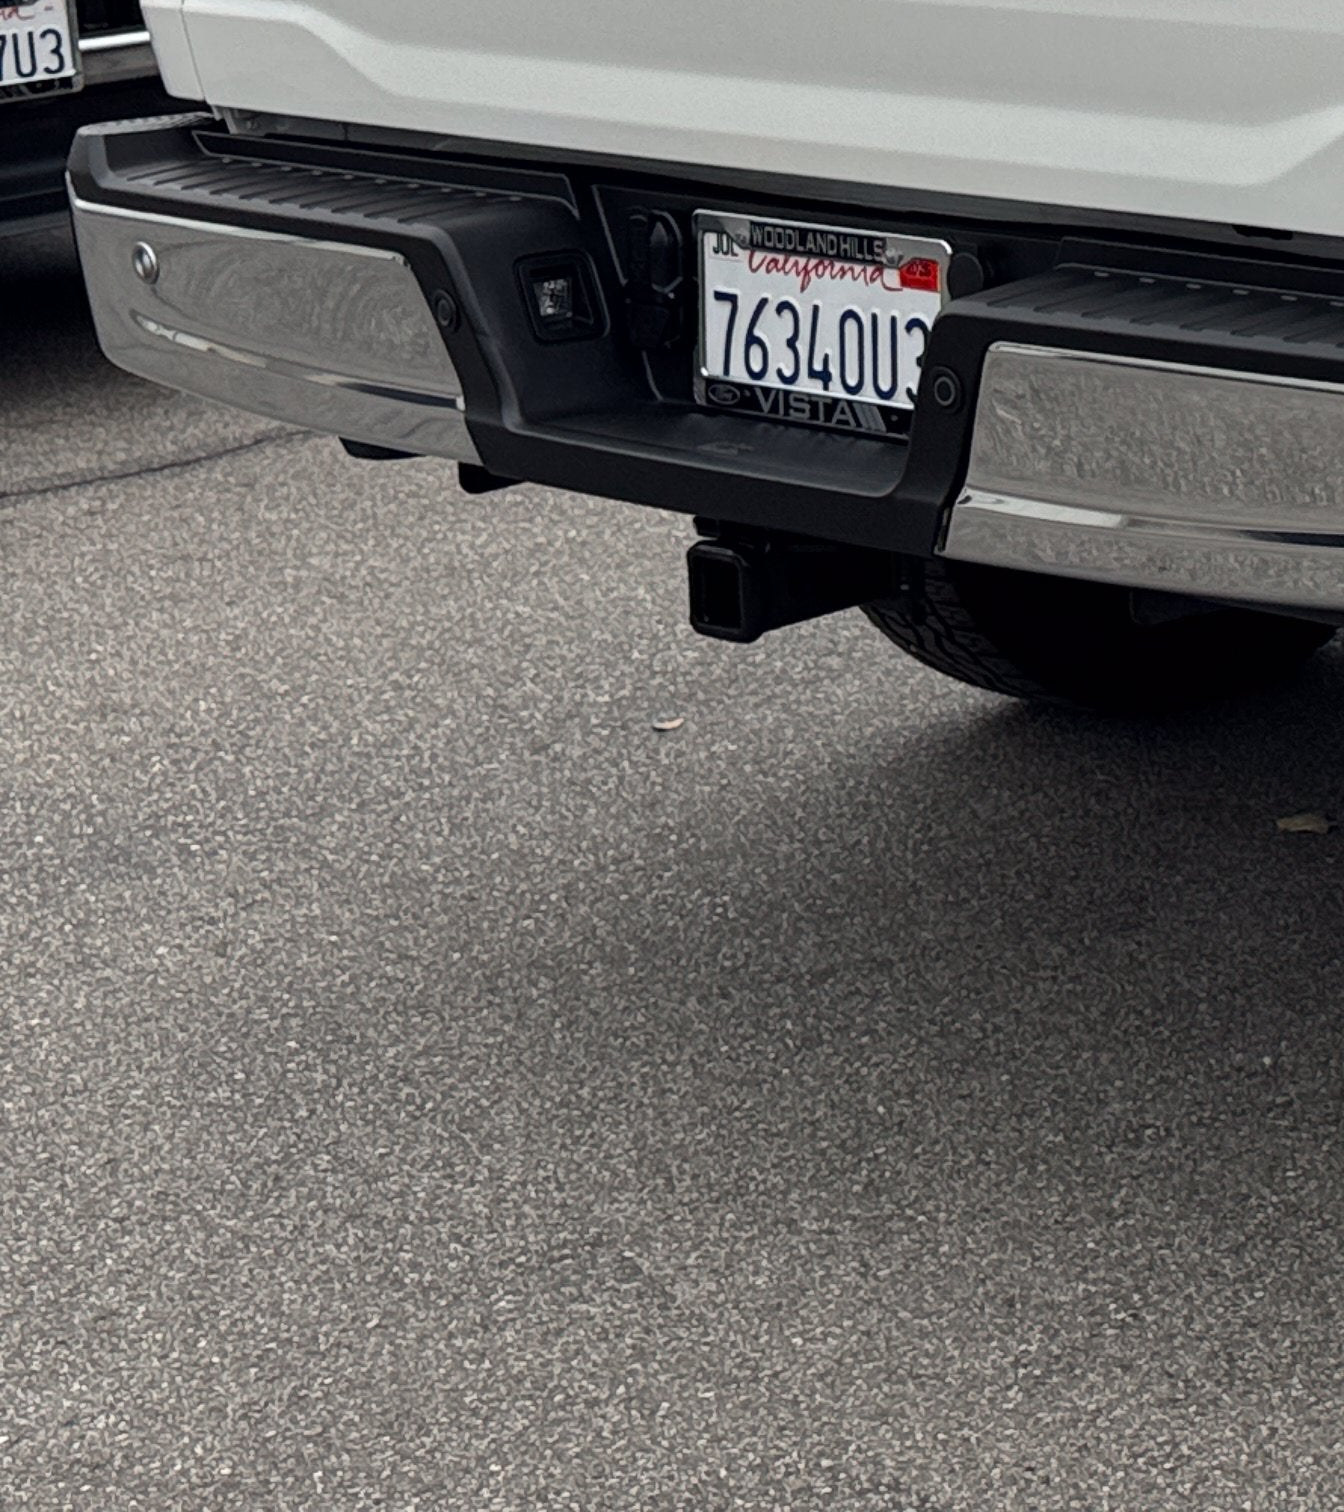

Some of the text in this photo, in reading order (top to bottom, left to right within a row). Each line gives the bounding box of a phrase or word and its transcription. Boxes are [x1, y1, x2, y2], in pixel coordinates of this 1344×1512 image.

[751, 224, 885, 263] WOODLAND HILLS
[753, 386, 858, 428] VISTA
